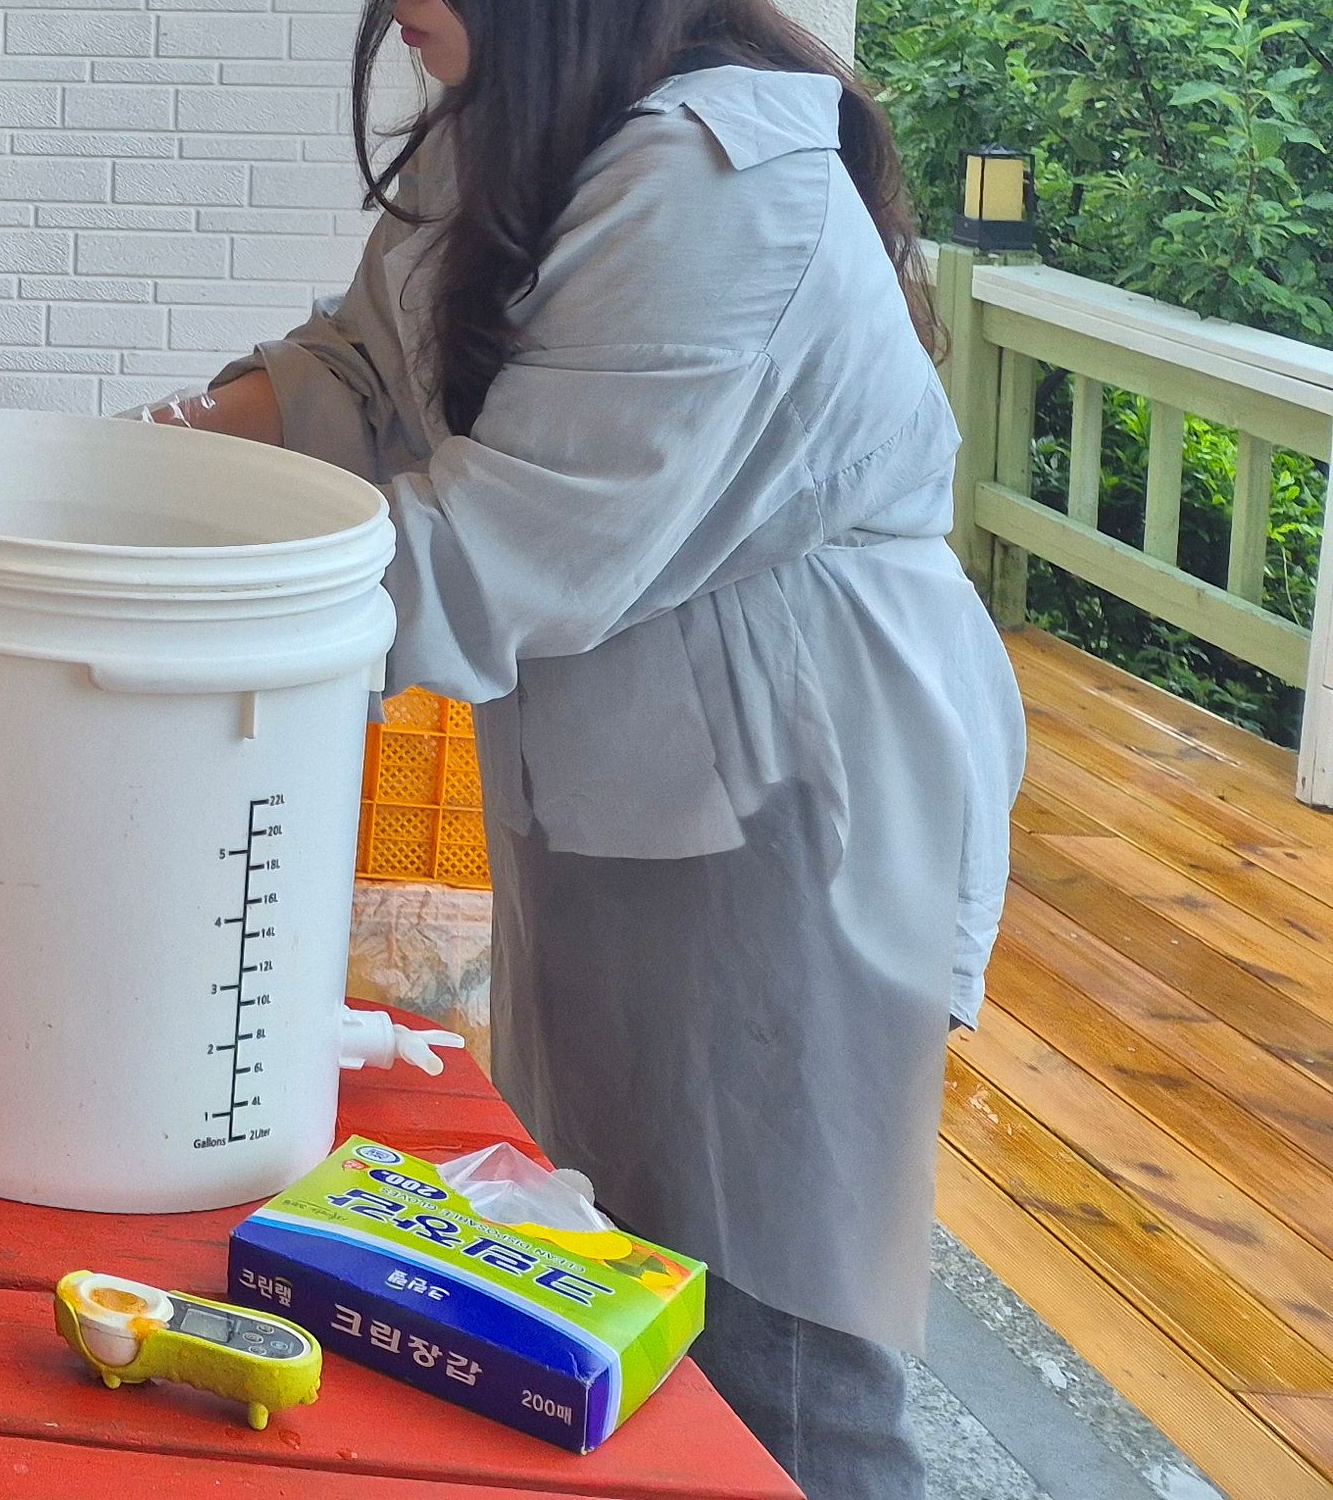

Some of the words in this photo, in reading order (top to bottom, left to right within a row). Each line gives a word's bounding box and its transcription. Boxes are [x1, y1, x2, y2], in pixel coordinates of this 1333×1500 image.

[269, 794, 285, 806] 22L
[267, 825, 283, 837] 20L
[266, 859, 281, 871] 18L
[264, 892, 278, 904] 16L
[261, 927, 275, 939] 14L
[259, 960, 273, 972] 12L
[257, 994, 271, 1006] 10L
[256, 1028, 267, 1039] 8L
[254, 1062, 264, 1073] 6L
[251, 1095, 262, 1106] 4L
[193, 1137, 227, 1149] Gallons
[381, 1187, 438, 1213] GLOVES
[442, 1208, 531, 1250] DISPOSABLE
[327, 1188, 615, 1307] 크린장갑
[535, 1248, 586, 1273] CLEAN
[238, 1268, 292, 1308] 크린랩
[385, 1268, 451, 1301] 크린랩
[331, 1303, 483, 1387] 크린장갑
[521, 1389, 573, 1427] 200매
